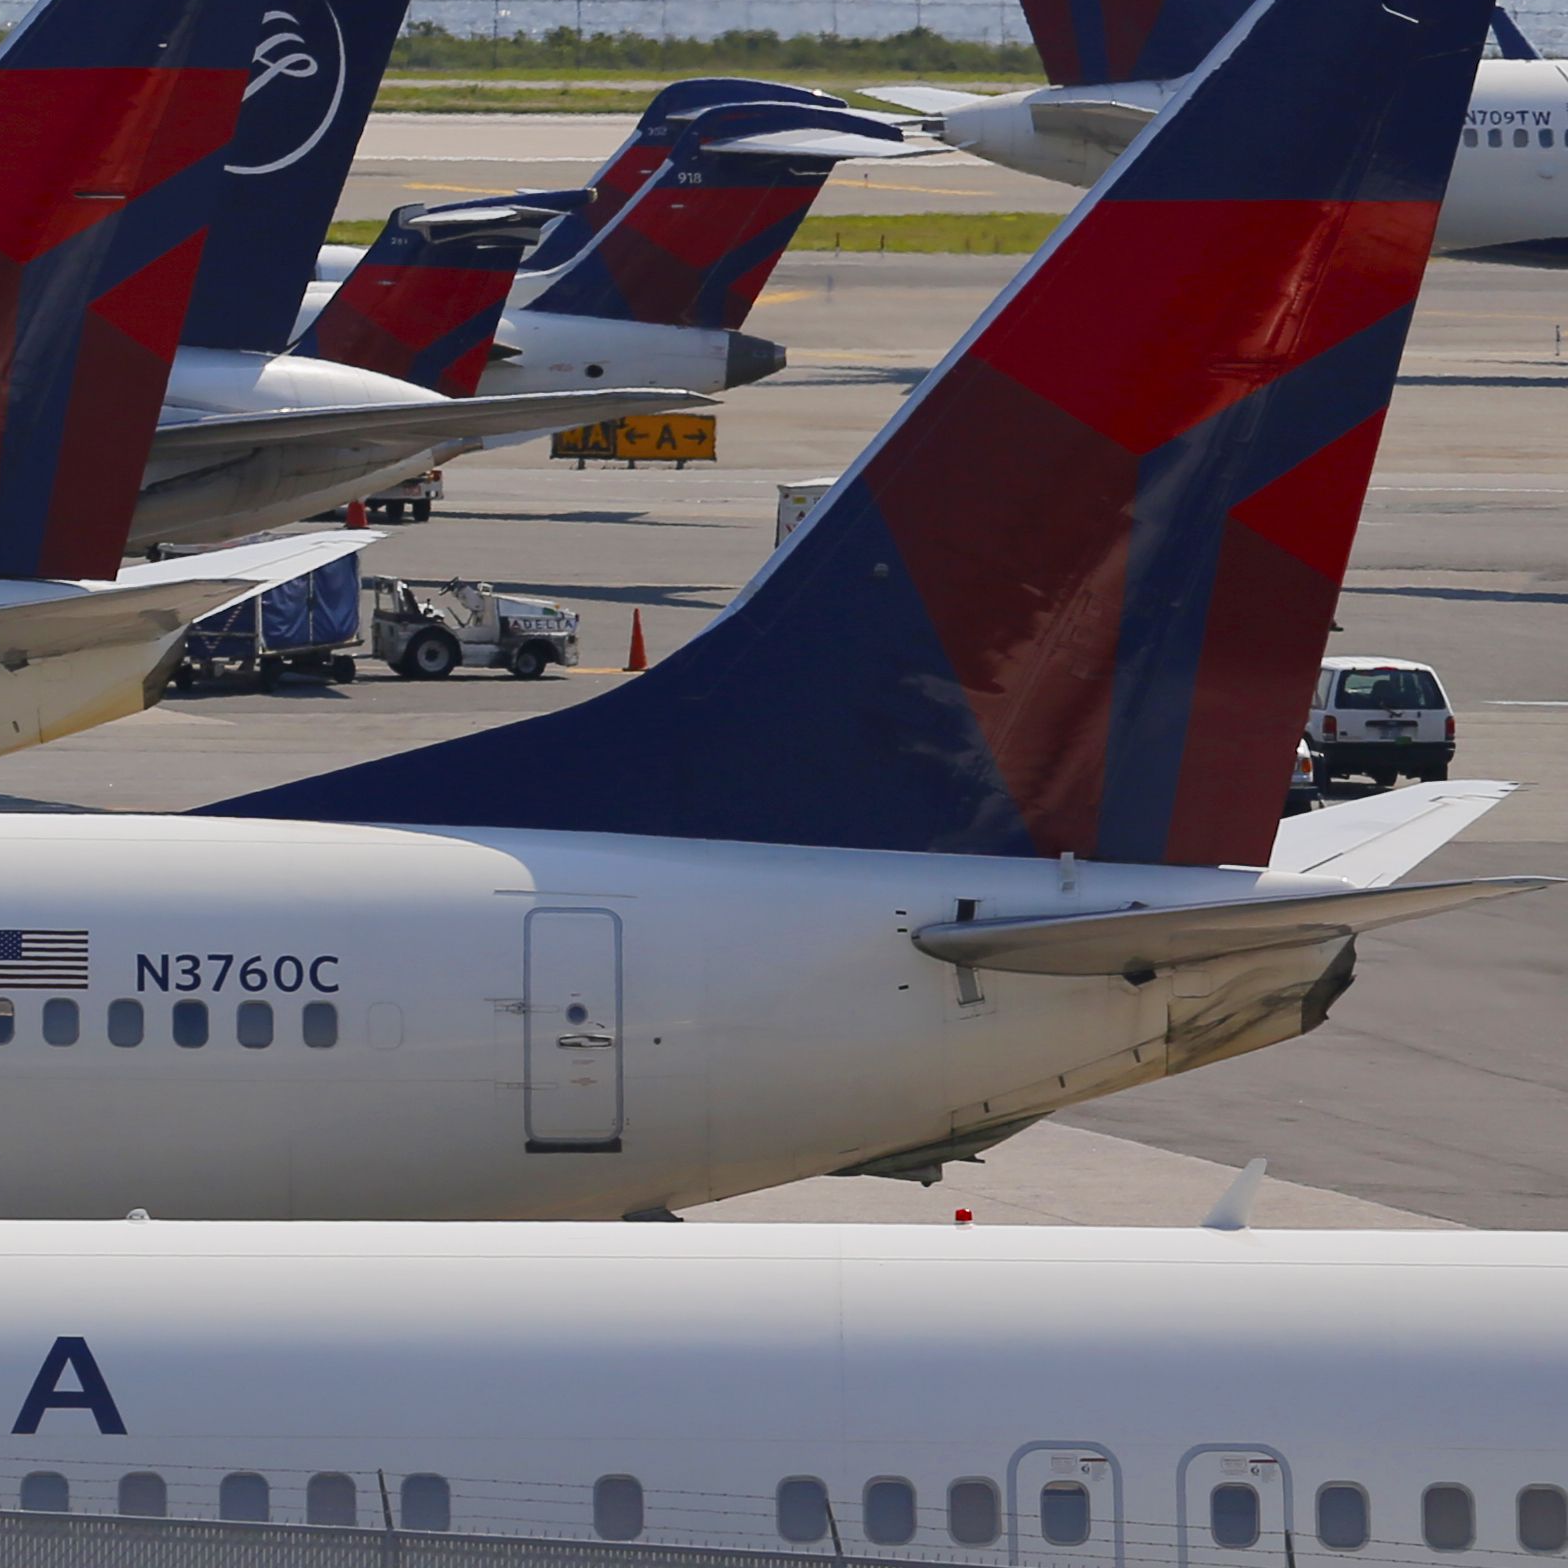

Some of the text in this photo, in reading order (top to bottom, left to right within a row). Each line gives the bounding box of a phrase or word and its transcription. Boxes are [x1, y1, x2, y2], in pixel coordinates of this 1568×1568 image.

[1465, 110, 1551, 126] N709TW
[678, 172, 702, 184] 918
[656, 424, 677, 450] A
[524, 619, 573, 630] DELTA
[135, 954, 339, 993] N3760C
